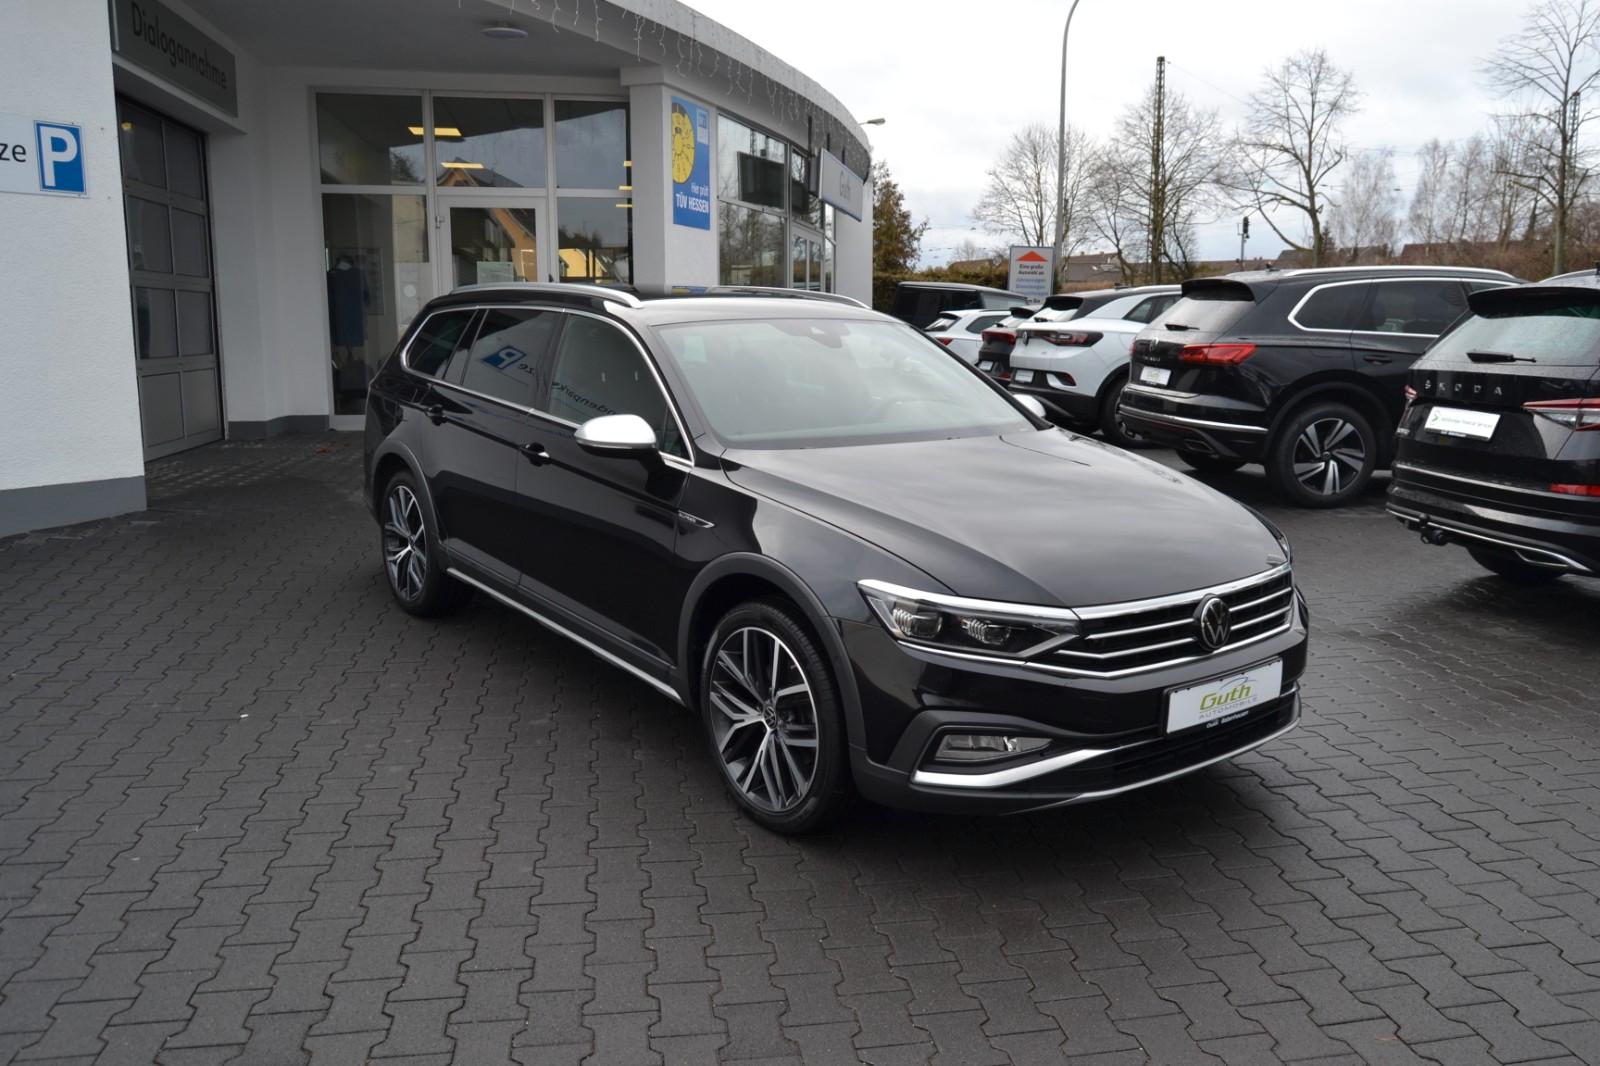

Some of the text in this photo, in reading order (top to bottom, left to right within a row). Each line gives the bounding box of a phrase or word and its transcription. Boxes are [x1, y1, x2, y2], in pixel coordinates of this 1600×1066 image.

[131, 2, 227, 90] Dialogannahme
[676, 191, 709, 214] TÜV HESSEN
[1198, 696, 1258, 719] AUTOMOBILE
[1200, 684, 1252, 711] Guth
